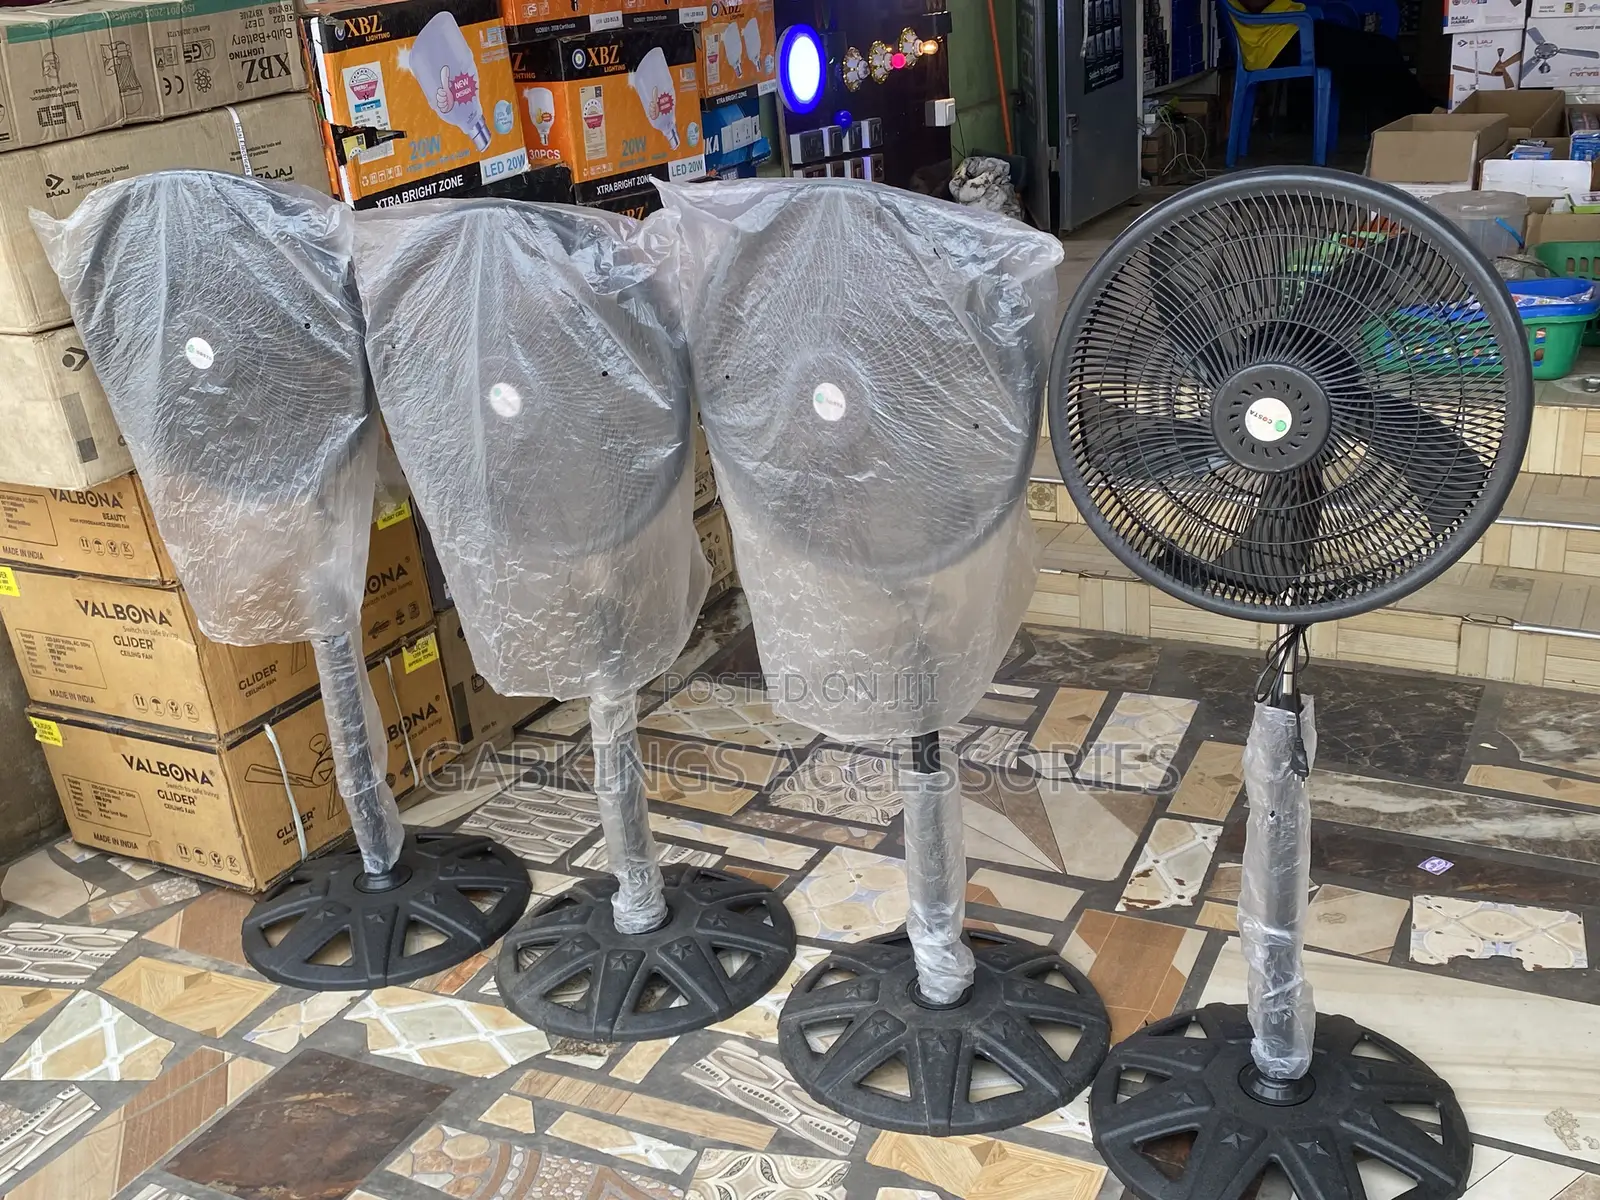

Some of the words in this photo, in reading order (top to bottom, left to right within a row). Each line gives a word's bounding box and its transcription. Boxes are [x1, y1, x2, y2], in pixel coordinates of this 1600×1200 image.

[244, 20, 257, 29] E27
[344, 14, 382, 38] XBZ
[231, 28, 293, 46] Bulb+Battery
[366, 32, 390, 42] LIGHTING
[229, 46, 265, 60] LIGHTING
[587, 44, 620, 68] XBZ
[241, 52, 292, 84] XBZ
[604, 64, 626, 72] LIGHTING
[454, 78, 468, 90] NEW
[37, 100, 82, 128] LED
[409, 134, 442, 160] 20W
[529, 150, 560, 161] 30PCS
[622, 136, 646, 158] 20W
[484, 162, 504, 178] LED
[506, 152, 526, 171] 20W
[672, 164, 687, 176] LED
[688, 160, 704, 173] 20W
[375, 194, 402, 208] XTRA
[402, 181, 438, 203] BRIGHT
[438, 174, 464, 192] ZONE
[596, 182, 614, 195] XTRA
[614, 177, 636, 190] BRIGHT
[1250, 409, 1272, 425] COSTA
[49, 488, 124, 510] VALBONA
[102, 512, 127, 522] BEAUTY
[2, 546, 20, 556] MADE
[20, 548, 28, 557] IN
[28, 550, 44, 561] INDIA
[76, 598, 172, 628] VALBONA
[122, 626, 142, 634] Switch
[150, 629, 162, 637] safe
[112, 634, 154, 650] GLIDER
[120, 650, 142, 659] CEILING
[142, 652, 154, 660] FAN
[238, 662, 278, 692] GLIDER
[49, 688, 68, 700] MADE
[68, 692, 77, 700] IN
[76, 694, 96, 704] INDIA
[244, 682, 266, 698] CEILING
[266, 676, 278, 688] FAN
[386, 702, 438, 744] BONA
[121, 753, 214, 788] VALBONA
[166, 782, 184, 790] Switch
[192, 786, 203, 794] safe
[157, 789, 197, 807] GLIDER
[164, 802, 184, 813] CEILING
[184, 806, 196, 815] FAN
[93, 832, 112, 843] MADE
[112, 836, 120, 845] IN
[120, 838, 139, 850] INDIA
